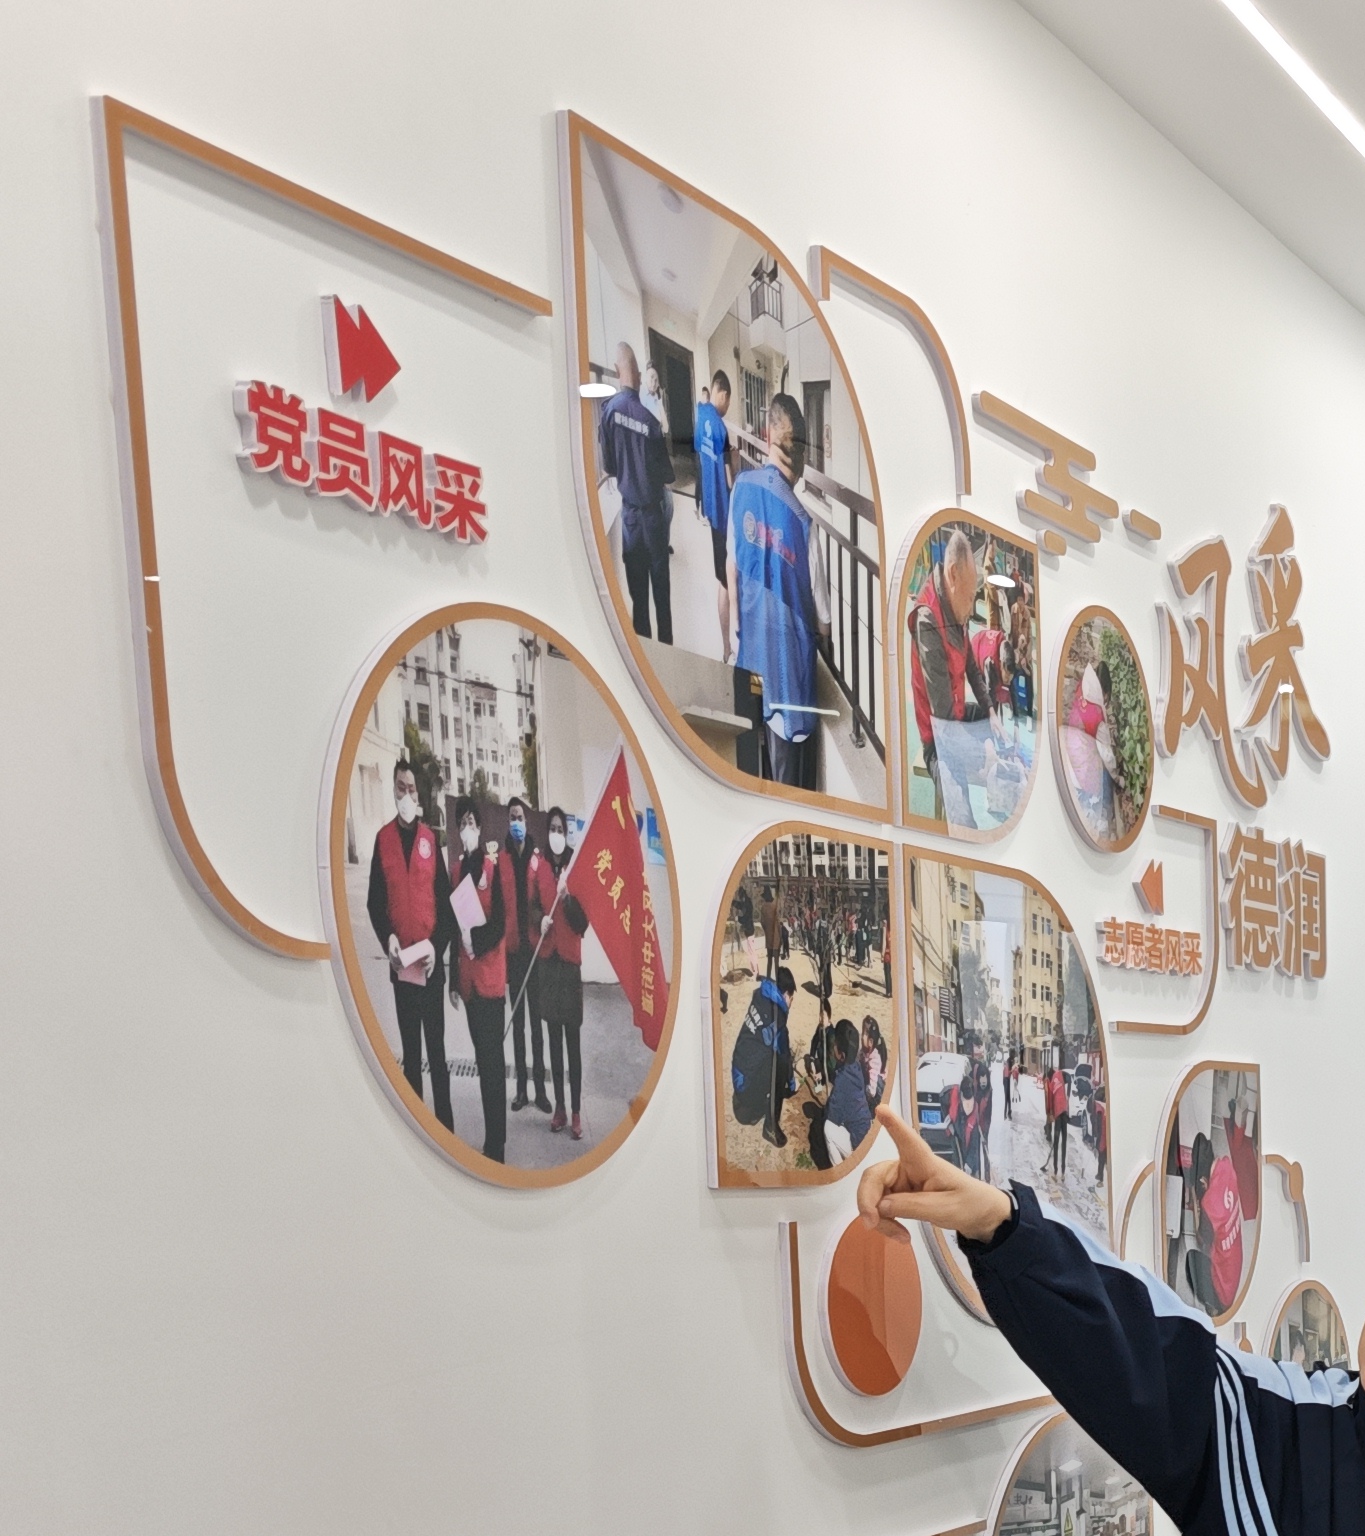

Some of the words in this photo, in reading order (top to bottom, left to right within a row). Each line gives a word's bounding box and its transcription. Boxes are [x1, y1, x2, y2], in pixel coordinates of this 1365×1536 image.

[246, 380, 488, 543] 党员风采
[1164, 507, 1329, 807] 风采
[1103, 916, 1202, 975] 志愿者风采
[1229, 828, 1326, 977] 德润
